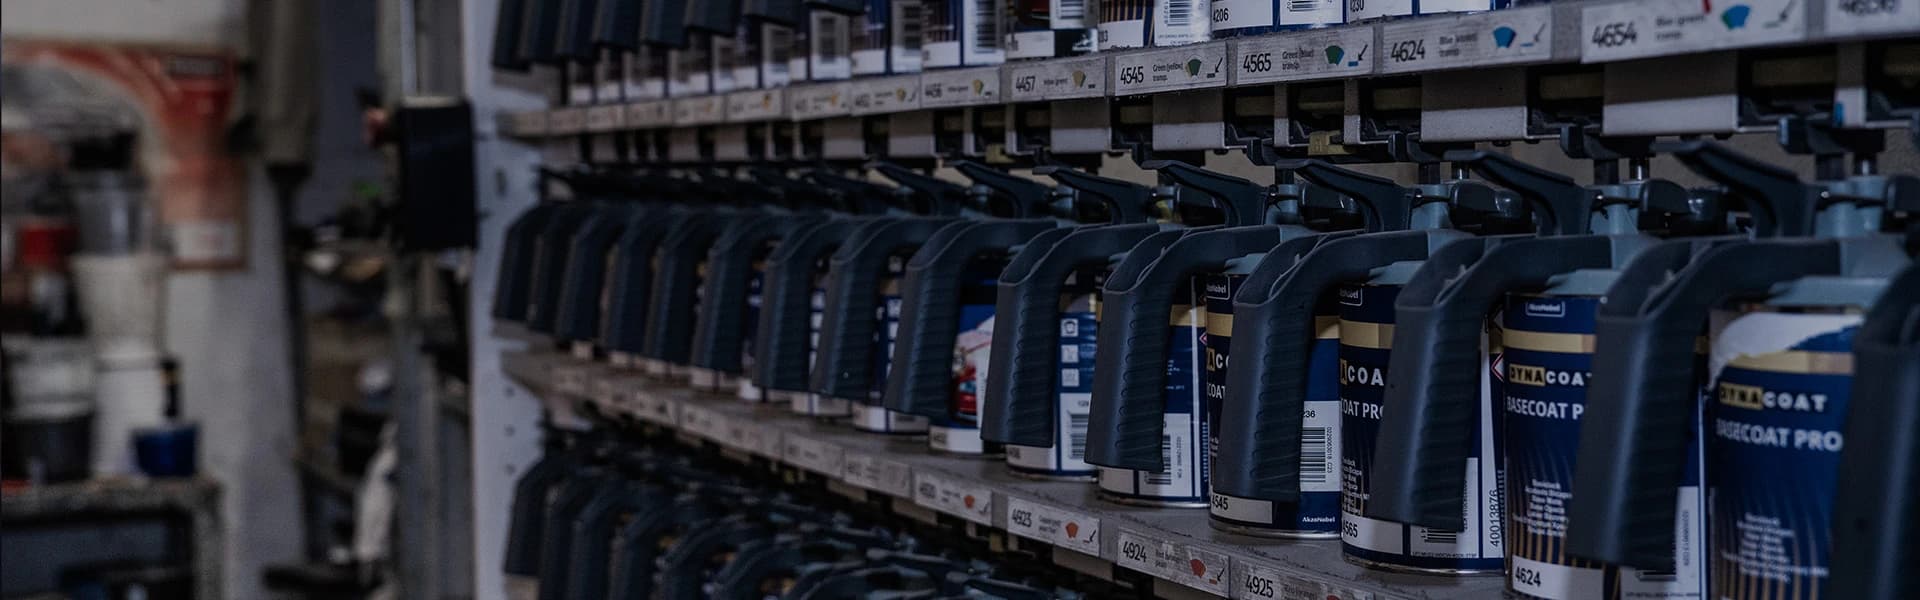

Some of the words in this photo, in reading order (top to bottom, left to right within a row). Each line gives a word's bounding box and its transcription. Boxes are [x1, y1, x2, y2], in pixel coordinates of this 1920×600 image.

[1592, 22, 1637, 47] 4654
[1391, 39, 1425, 62] 4624
[1243, 53, 1272, 73] 4565
[1120, 66, 1144, 84] 4545
[1341, 397, 1360, 417] OAT
[1506, 395, 1569, 420] BASECOAT
[1716, 417, 1791, 448] BASECOAT
[1793, 428, 1844, 453] PRO
[1012, 508, 1033, 528] 4923
[1489, 489, 1501, 548] 40013876
[1123, 541, 1147, 563] 4924
[1246, 574, 1274, 598] 4925
[1515, 566, 1542, 588] 4624
